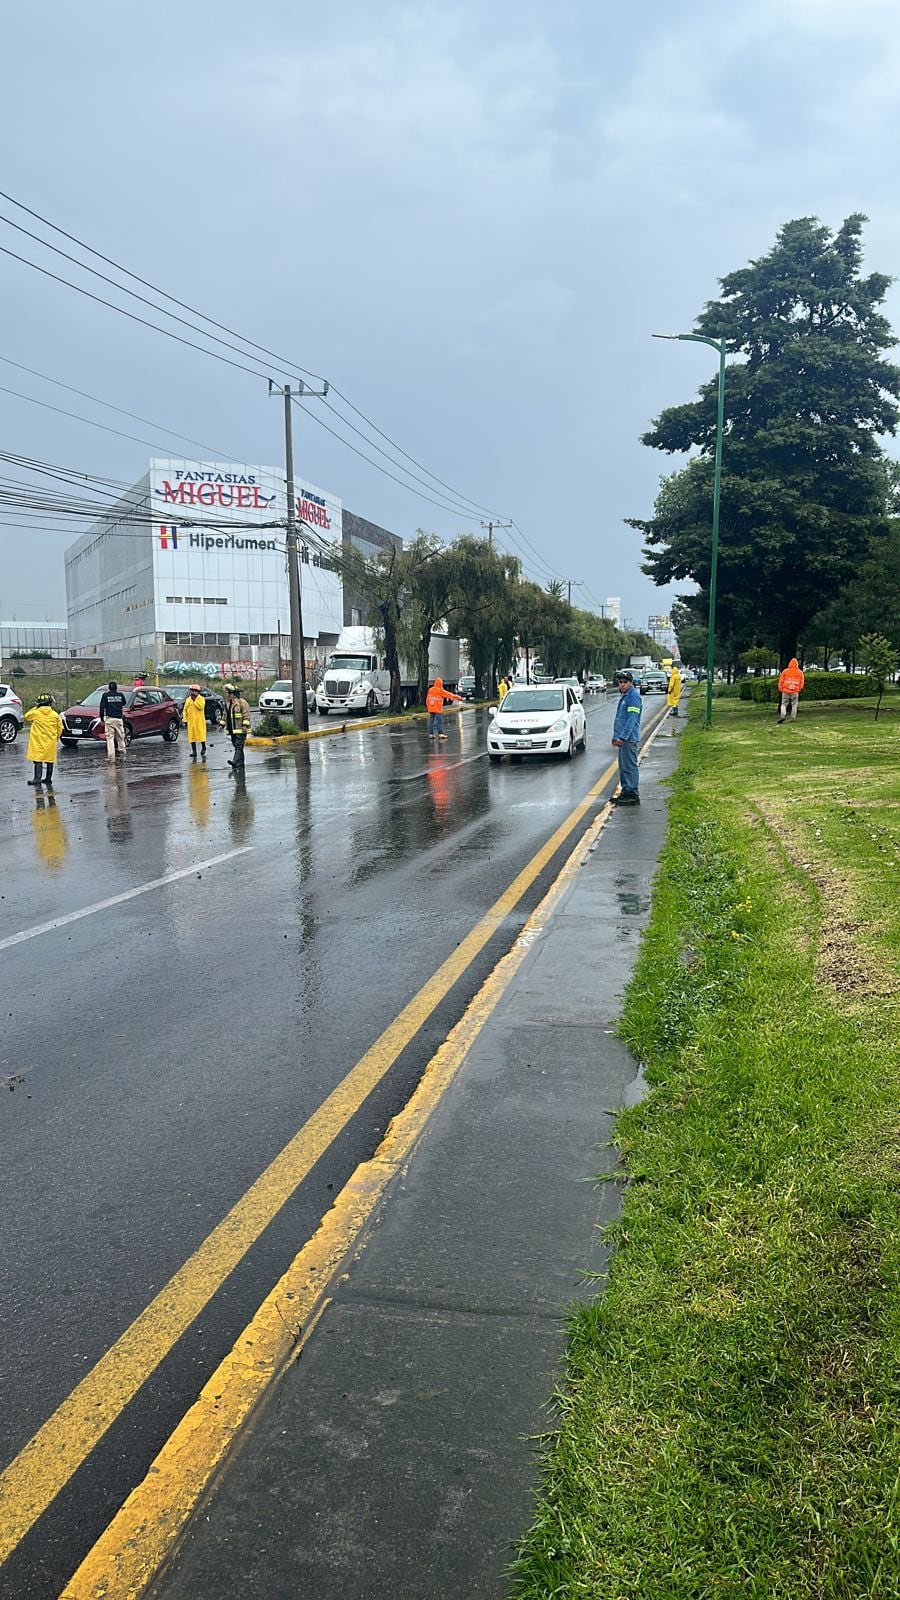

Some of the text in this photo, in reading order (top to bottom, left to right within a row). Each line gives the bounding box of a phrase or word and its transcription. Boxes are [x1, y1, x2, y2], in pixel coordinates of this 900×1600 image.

[175, 471, 256, 484] FANTASIAS
[161, 480, 269, 509] MIGUEL
[301, 489, 326, 507] FANTASIAS
[297, 497, 331, 530] MIGUEL
[189, 533, 276, 551] Hiperlumen
